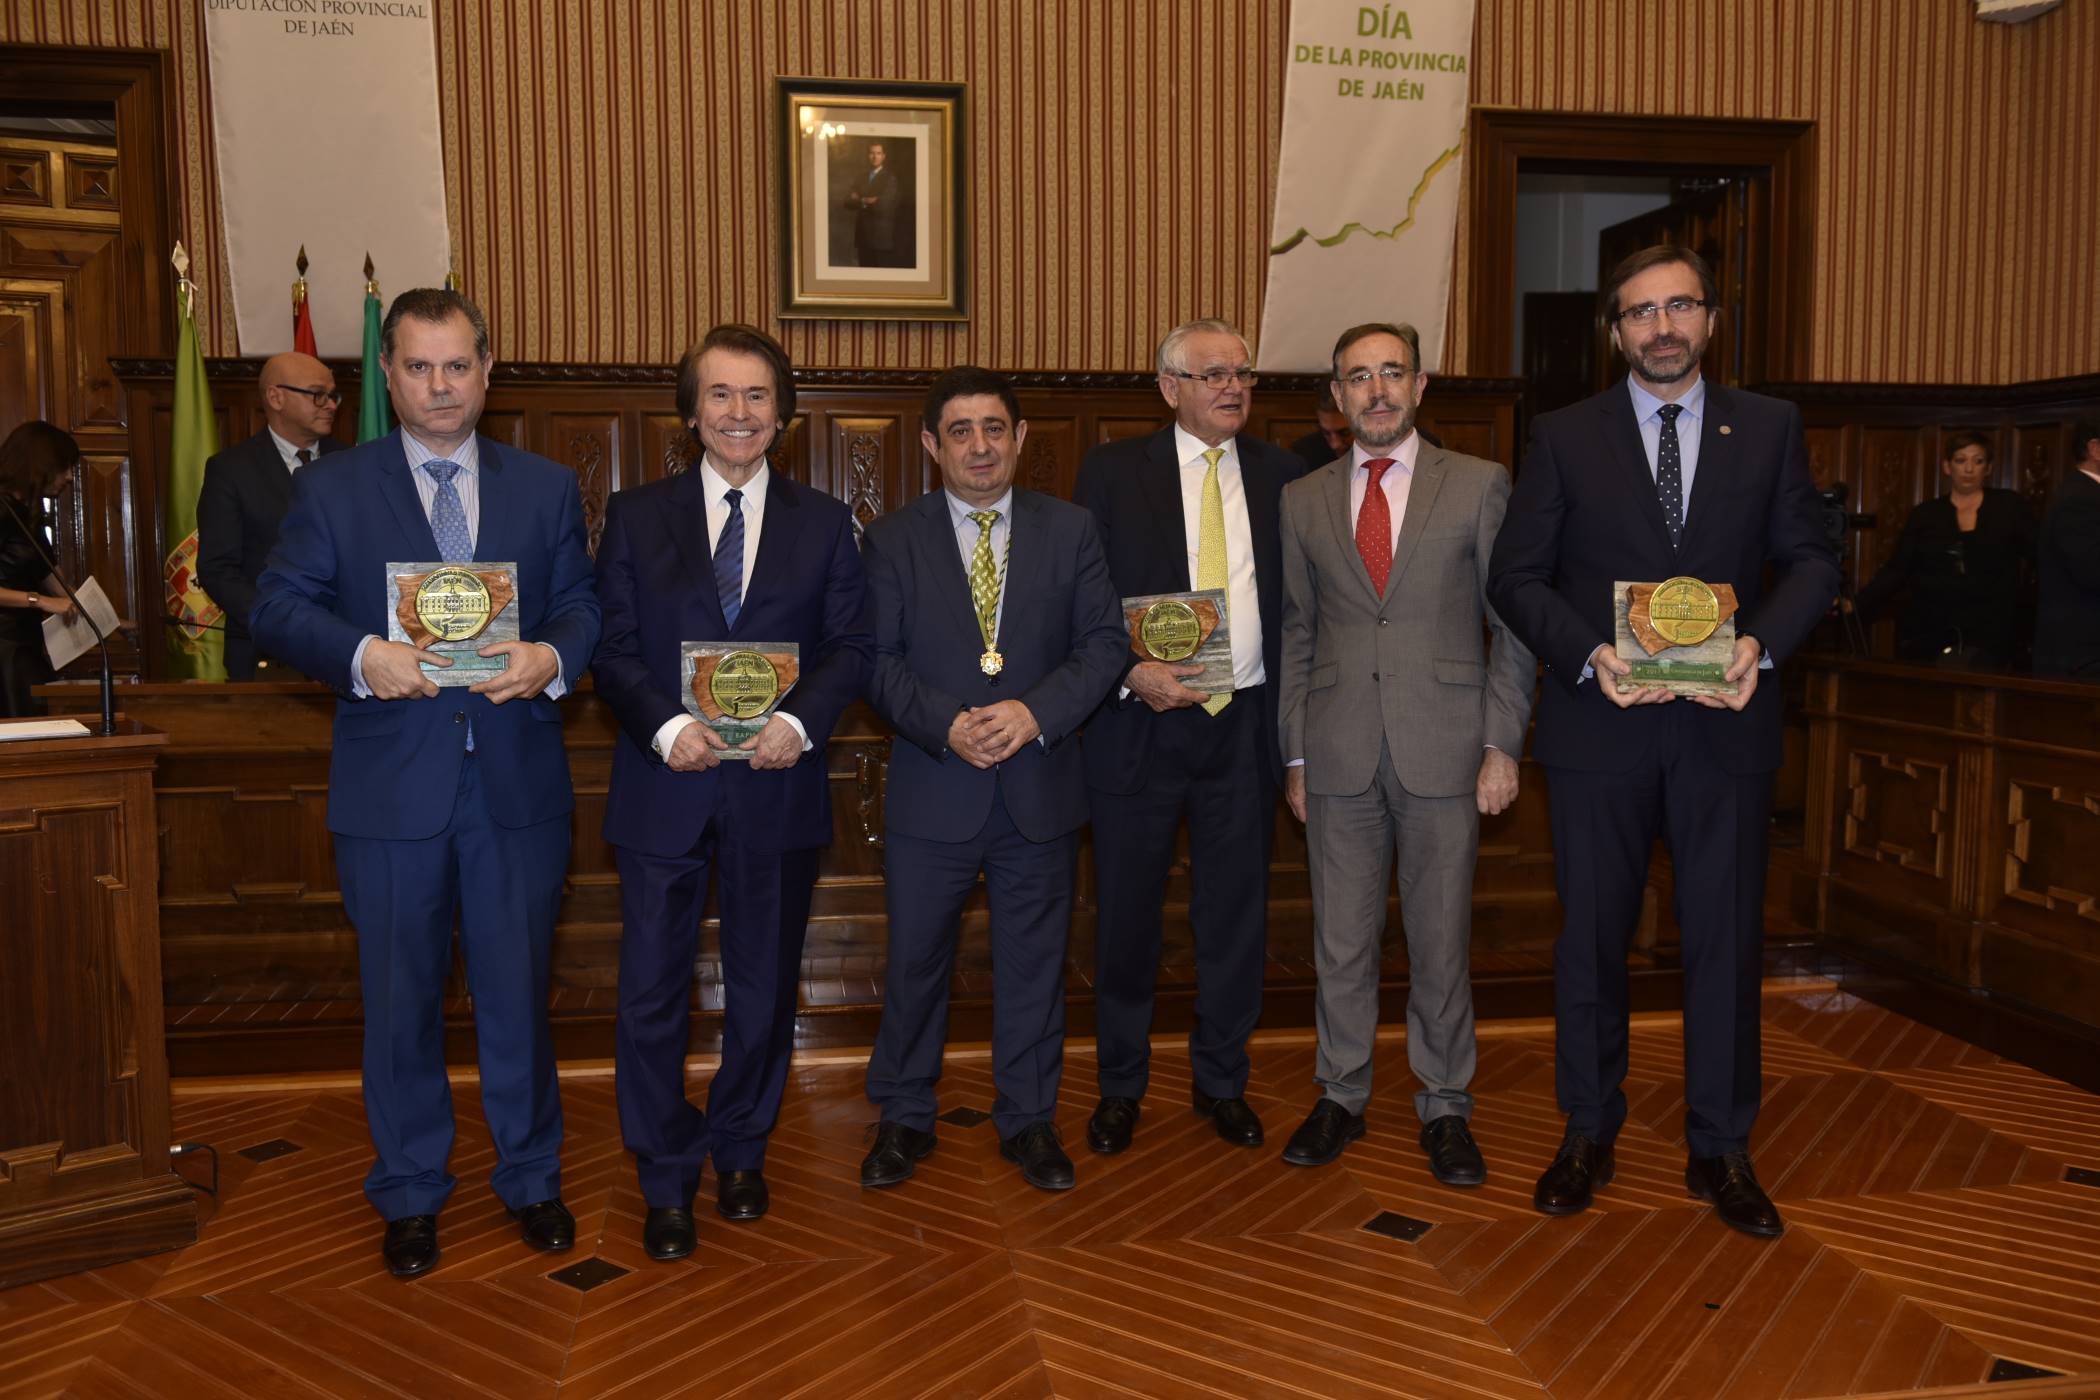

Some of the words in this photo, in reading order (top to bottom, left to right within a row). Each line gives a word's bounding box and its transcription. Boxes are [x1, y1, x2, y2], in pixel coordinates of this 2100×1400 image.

[322, 1, 427, 18] PROVINCIAL
[284, 20, 307, 33] DE
[312, 19, 354, 36] JAÉN
[1357, 4, 1413, 40] DÍA
[1295, 45, 1323, 64] DE
[1328, 47, 1352, 66] LA
[1358, 50, 1467, 73] PROVINCIA
[1338, 78, 1364, 97] DE
[1372, 79, 1425, 100] JAÉN
